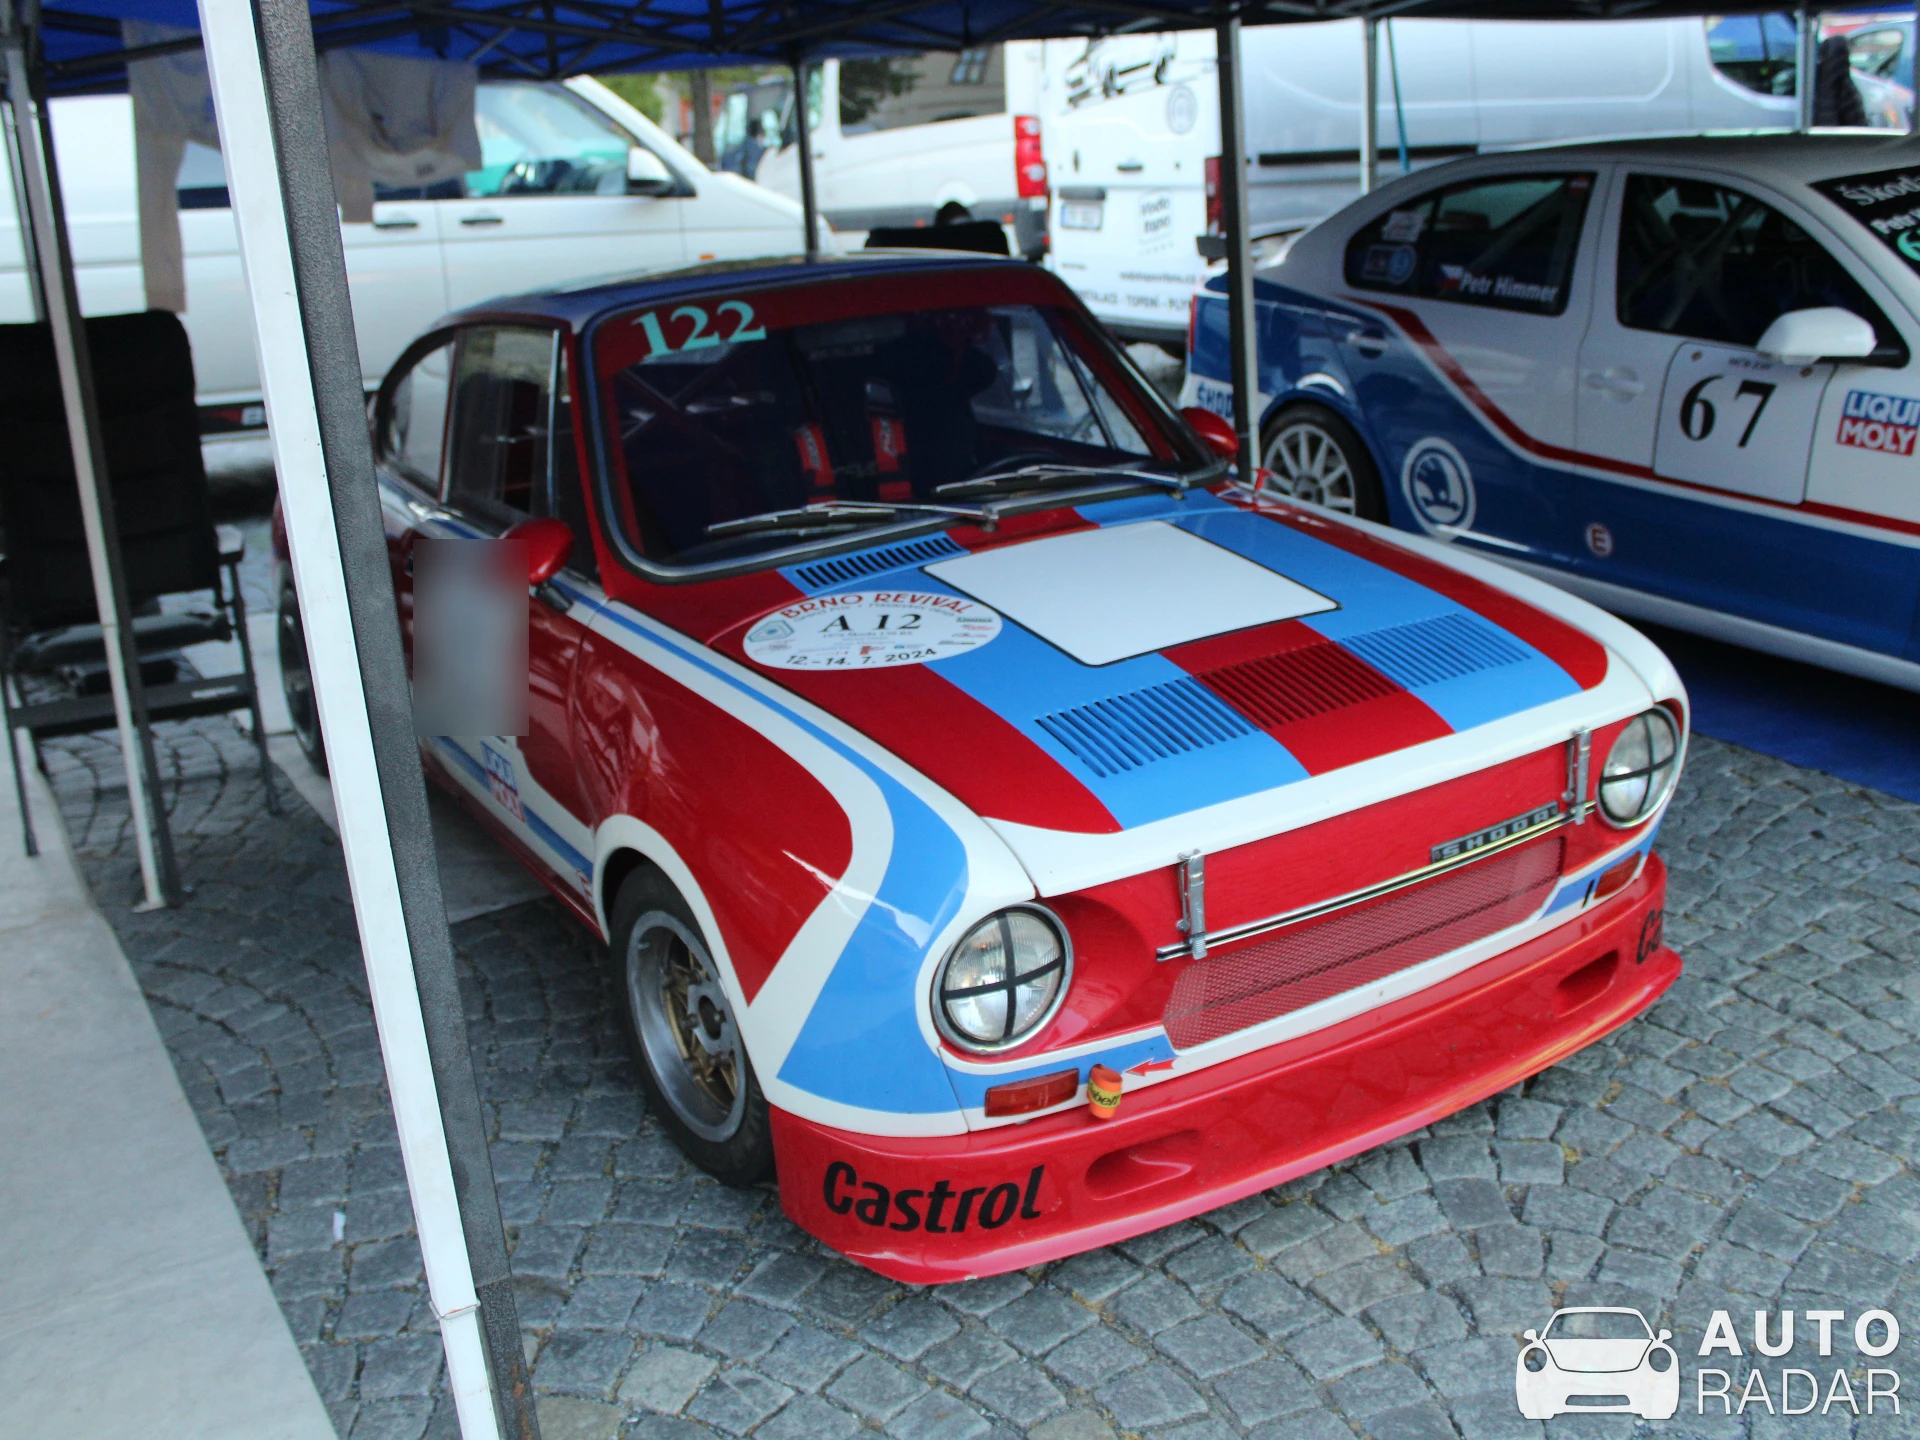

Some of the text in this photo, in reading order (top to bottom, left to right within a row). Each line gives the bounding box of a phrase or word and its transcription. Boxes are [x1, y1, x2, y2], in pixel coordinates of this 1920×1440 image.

[1834, 174, 1920, 206] Škod
[1460, 272, 1560, 304] Petr Himmer
[632, 300, 767, 358] 122
[1680, 374, 1777, 449] 67
[1847, 391, 1920, 428] LIQUI
[1839, 420, 1918, 454] MOLY
[780, 594, 864, 619] BRNO
[874, 593, 974, 614] REVIVAL
[819, 613, 922, 633] A 12
[885, 648, 937, 662] 2024
[823, 1161, 1045, 1233] Castrol
